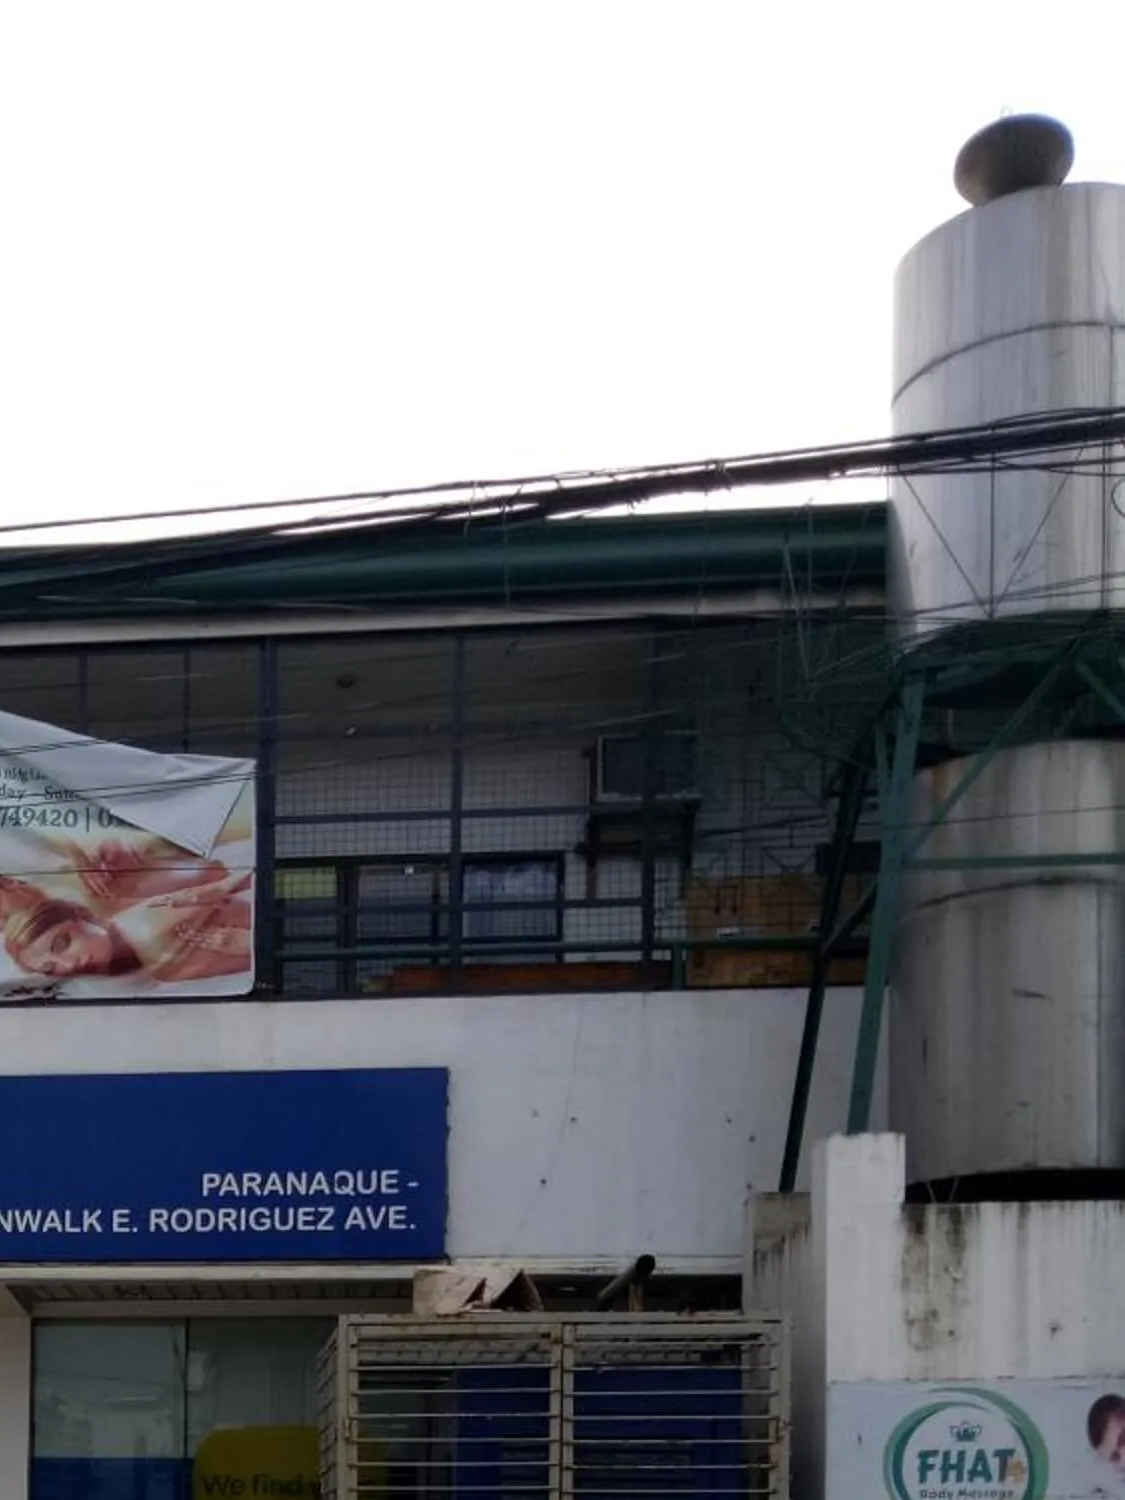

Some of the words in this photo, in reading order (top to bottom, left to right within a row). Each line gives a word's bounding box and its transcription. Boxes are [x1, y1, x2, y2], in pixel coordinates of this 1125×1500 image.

[203, 1169, 400, 1197] PARANAQUE
[112, 1208, 139, 1234] E.
[149, 1206, 335, 1234] RODRIGUEZ
[344, 1205, 417, 1232] AVE.
[917, 1448, 1016, 1485] FHAT
[202, 1474, 245, 1495] We
[253, 1473, 304, 1495] find
